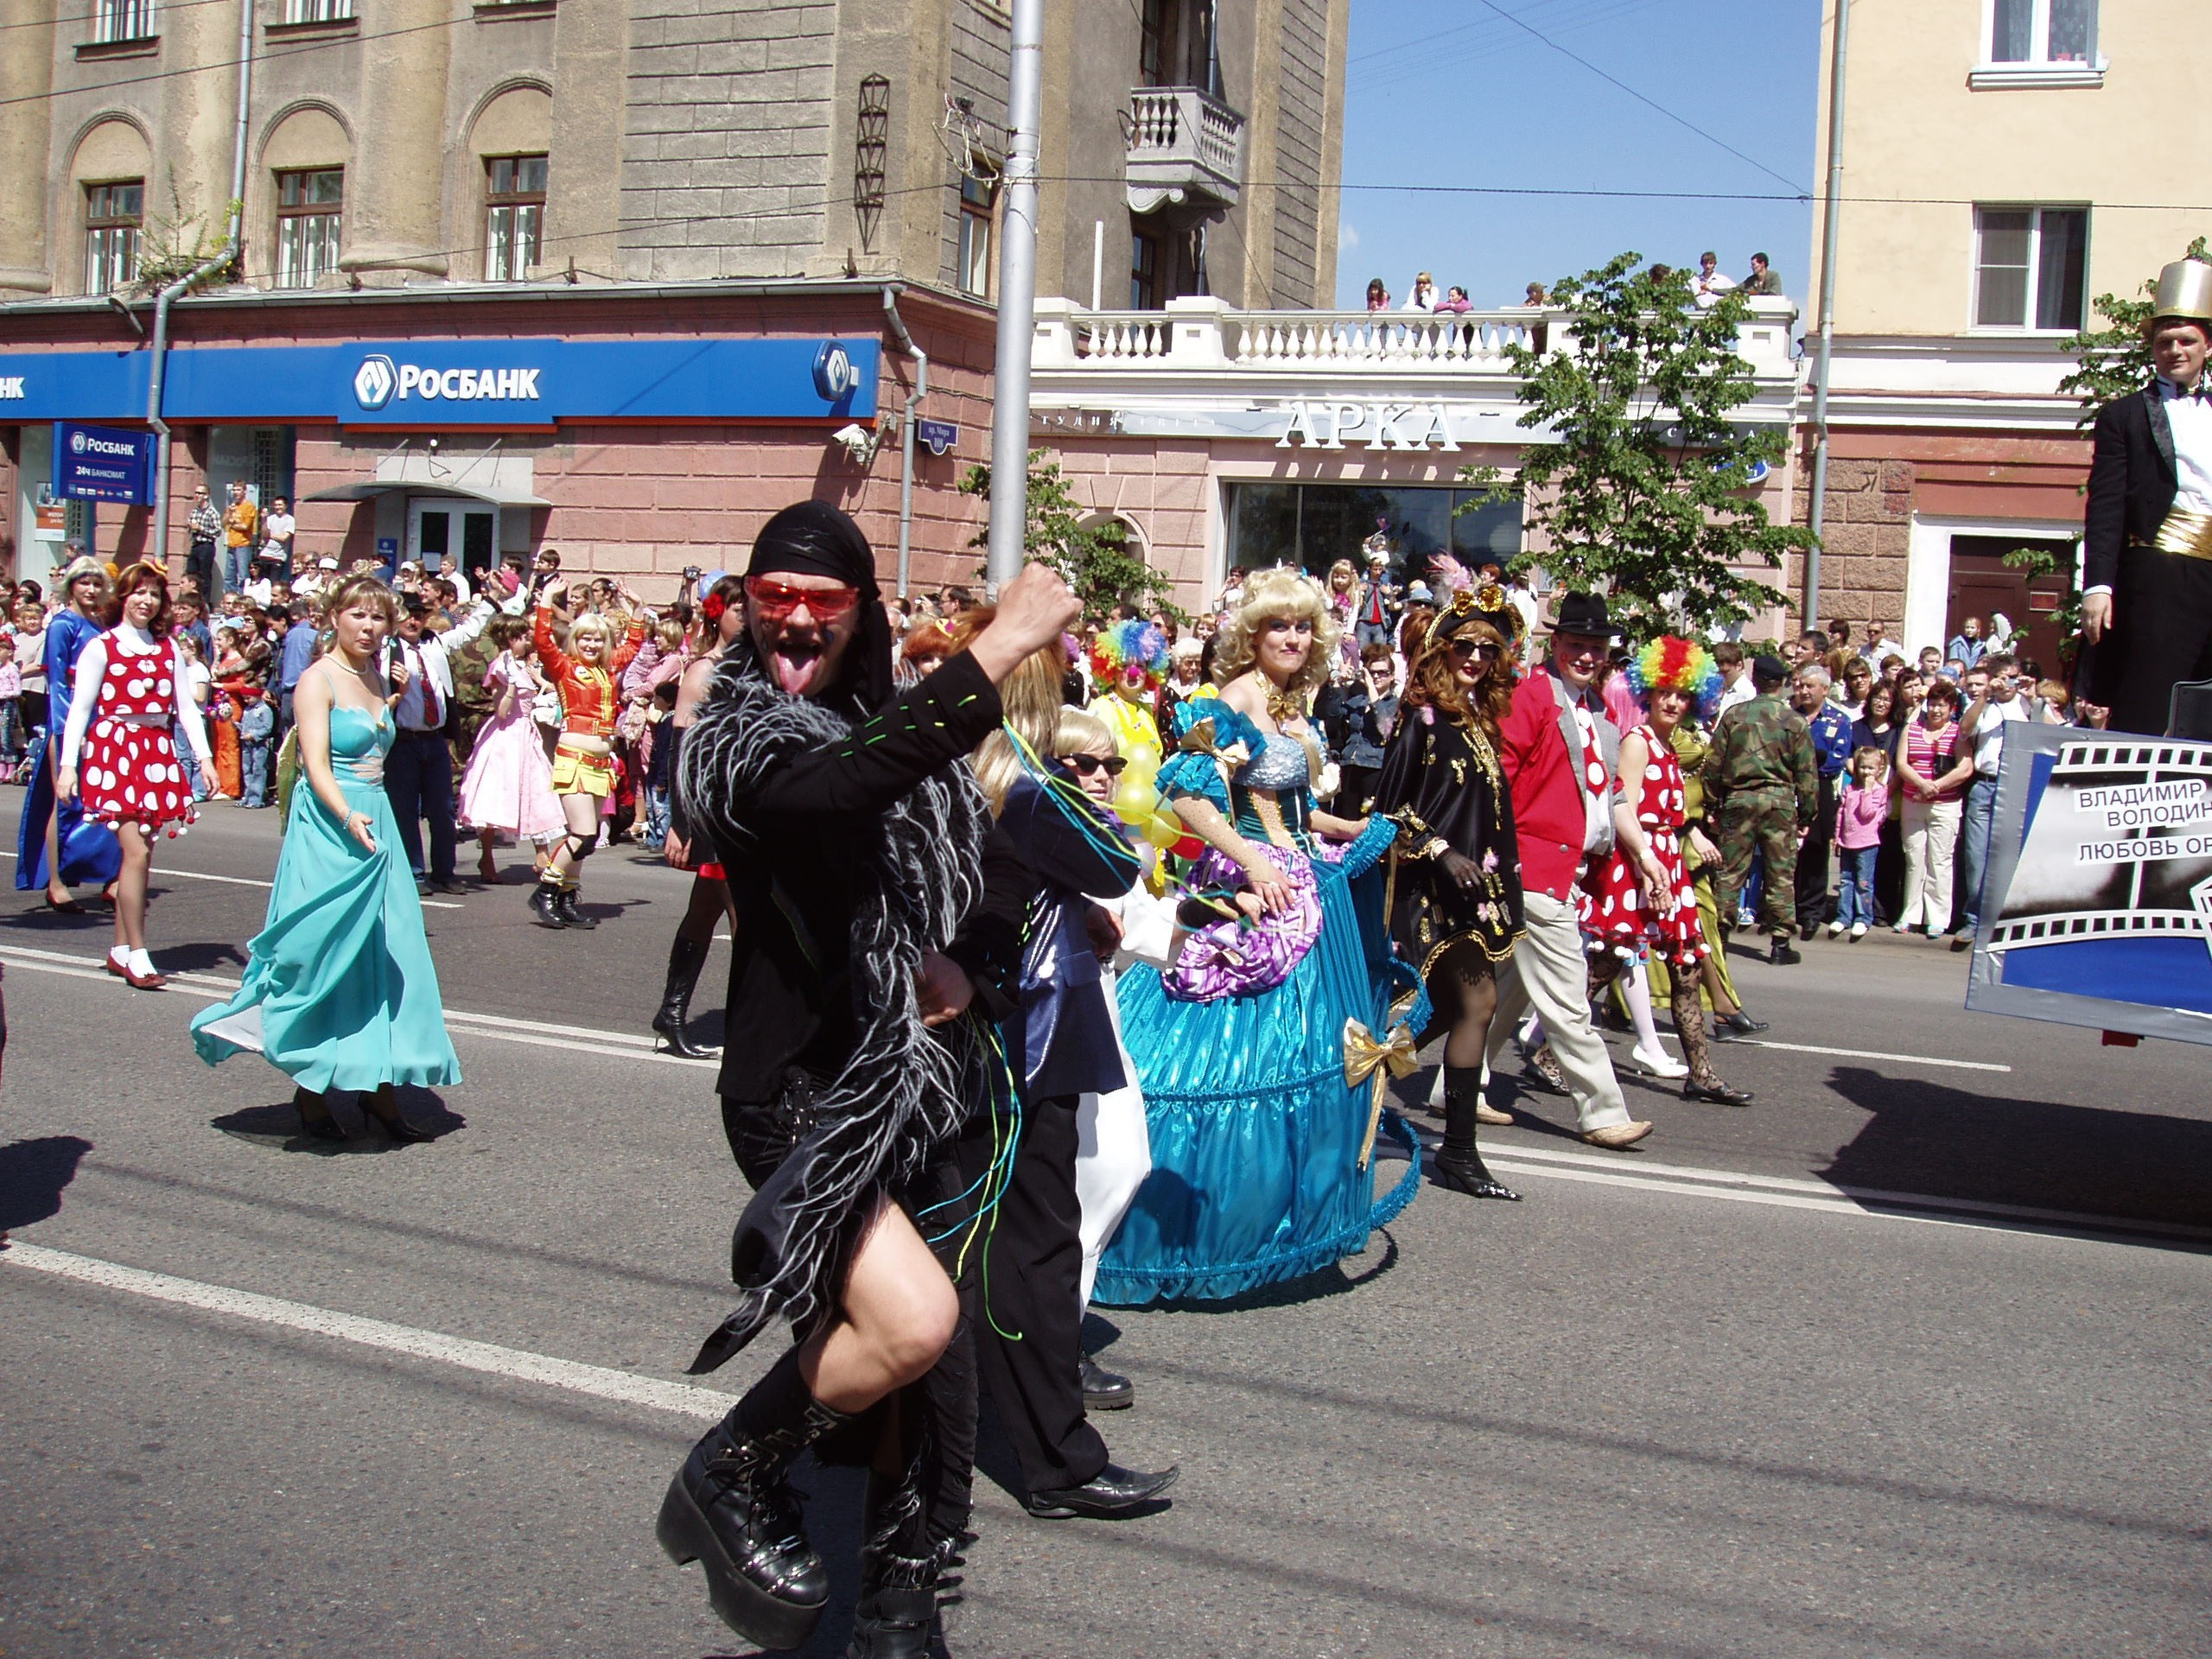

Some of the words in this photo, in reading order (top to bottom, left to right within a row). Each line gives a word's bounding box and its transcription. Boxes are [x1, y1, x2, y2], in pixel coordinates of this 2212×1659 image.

[0, 377, 25, 399] НК
[398, 365, 540, 400] РОСБАНК
[1029, 416, 1117, 429] ТУДИЯ
[1275, 401, 1461, 451] АРКА
[87, 438, 135, 456] РОСБАНК
[92, 469, 126, 480] БАНКОМАТ
[2080, 782, 2202, 808] ВЛАДИМИР
[2107, 801, 2212, 827] ВОЛОДИН
[2080, 840, 2178, 861] ЛЮБОВЬ
